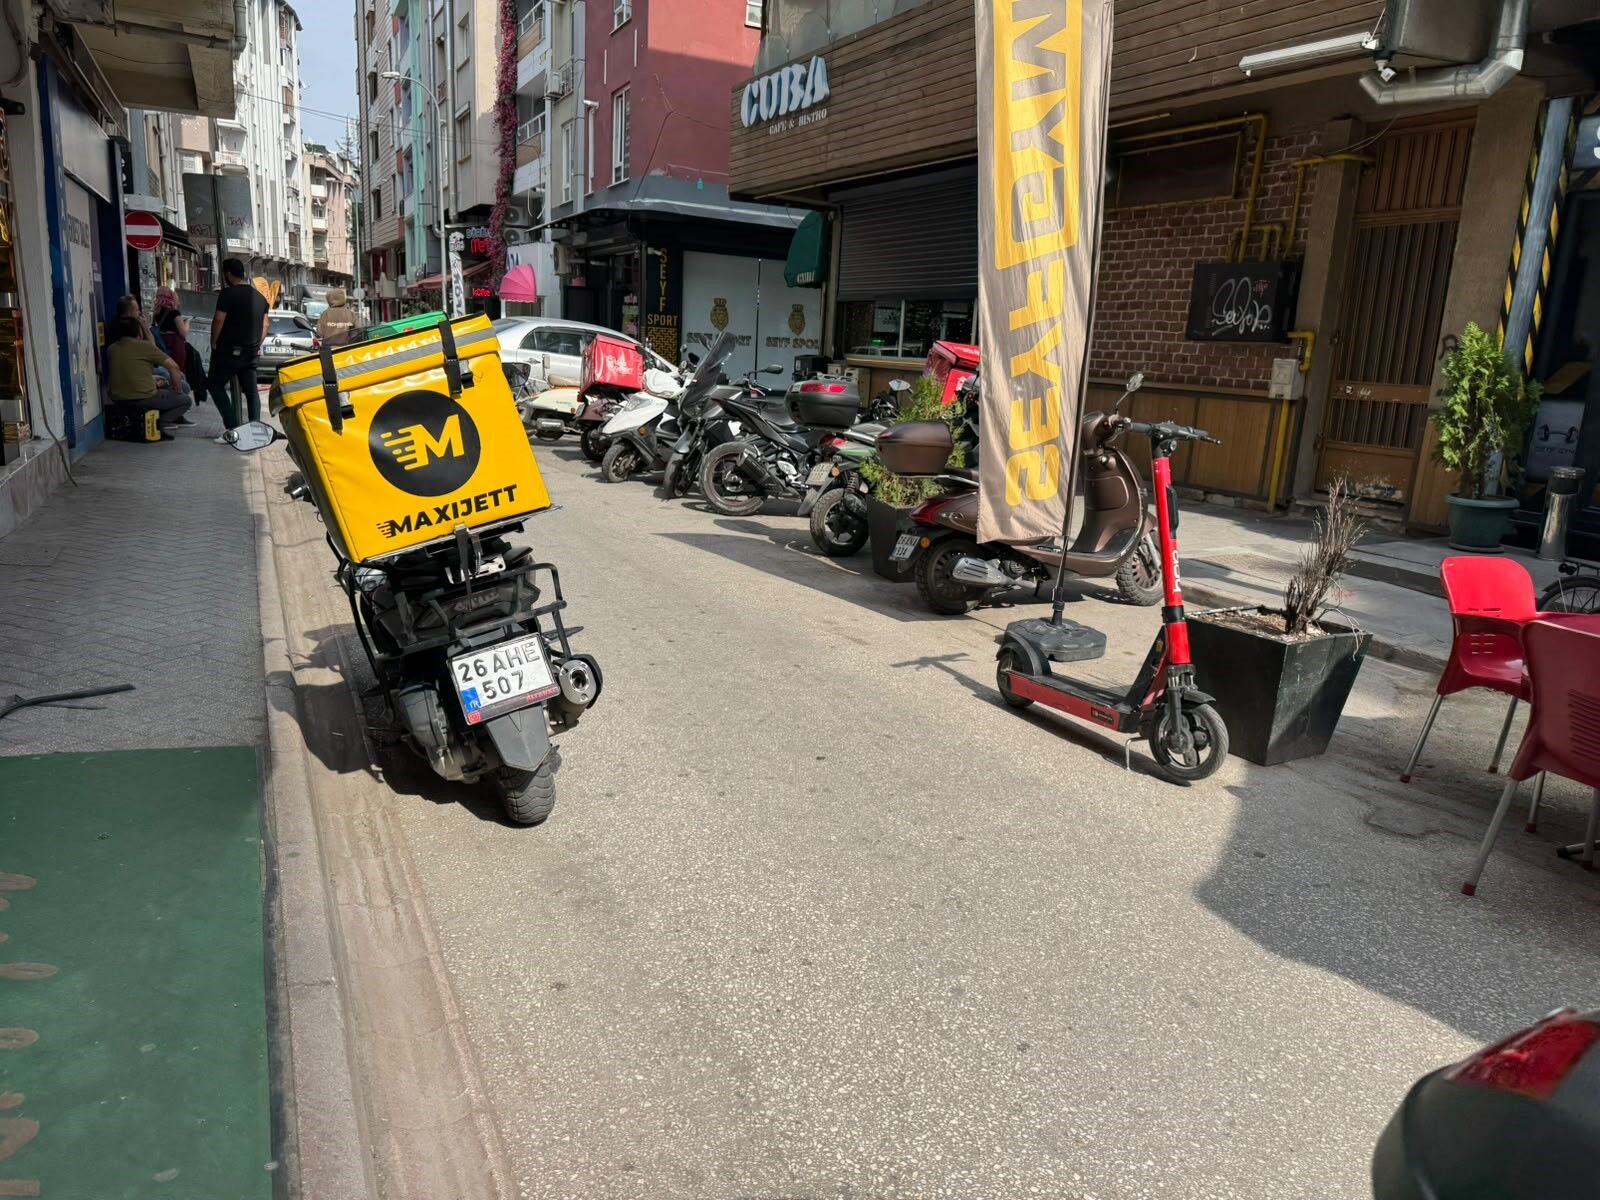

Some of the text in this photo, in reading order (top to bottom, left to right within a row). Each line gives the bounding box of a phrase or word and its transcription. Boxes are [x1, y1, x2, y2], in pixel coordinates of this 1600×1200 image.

[740, 55, 830, 128] CUBA
[769, 108, 828, 135] CAFE & BISTRO
[659, 248, 668, 312] SEYF
[647, 313, 679, 327] SPORT
[376, 484, 518, 538] MAXIJETT
[458, 641, 540, 683] 26 AHE
[482, 669, 524, 700] 507
